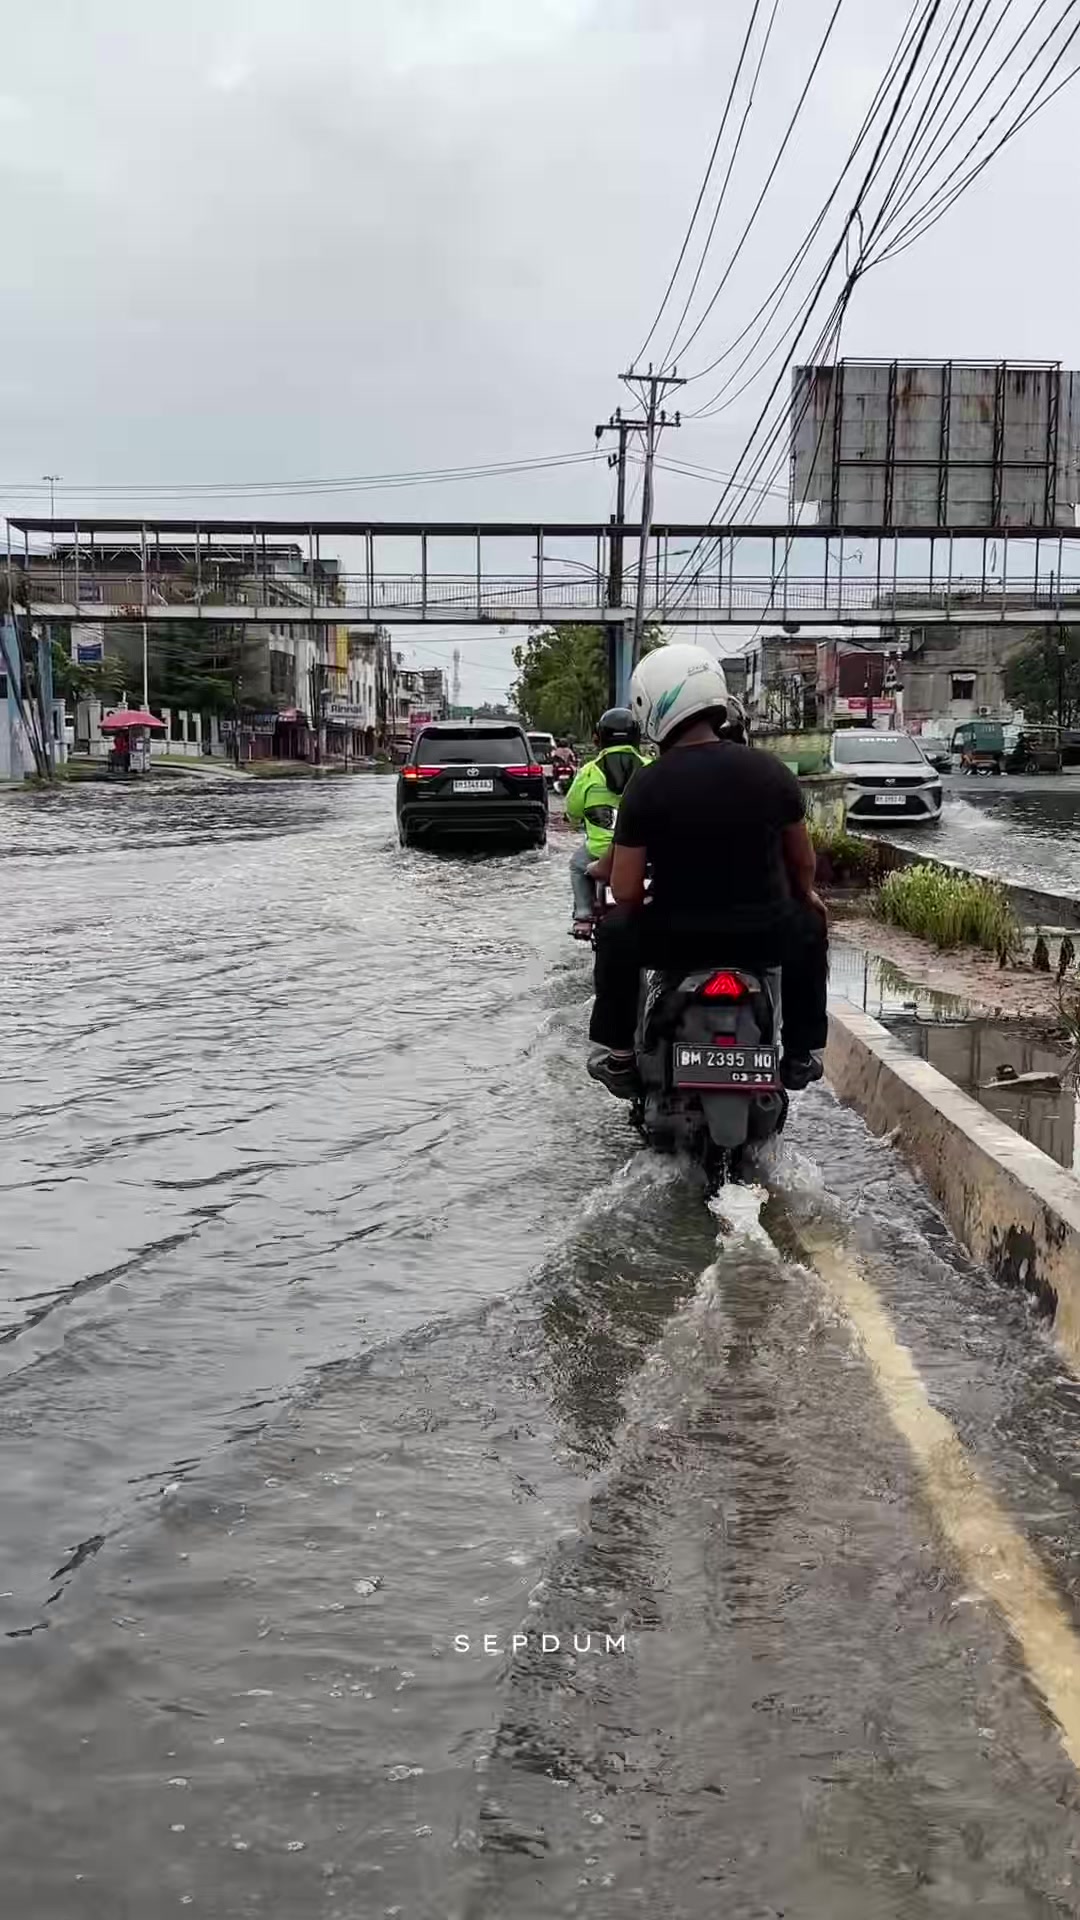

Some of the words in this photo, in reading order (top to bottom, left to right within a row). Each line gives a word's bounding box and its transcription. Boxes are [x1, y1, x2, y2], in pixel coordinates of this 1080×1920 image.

[331, 705, 362, 713] Rinnai
[681, 1051, 701, 1066] BM
[707, 1052, 745, 1067] 2395
[754, 1073, 772, 1082] 27
